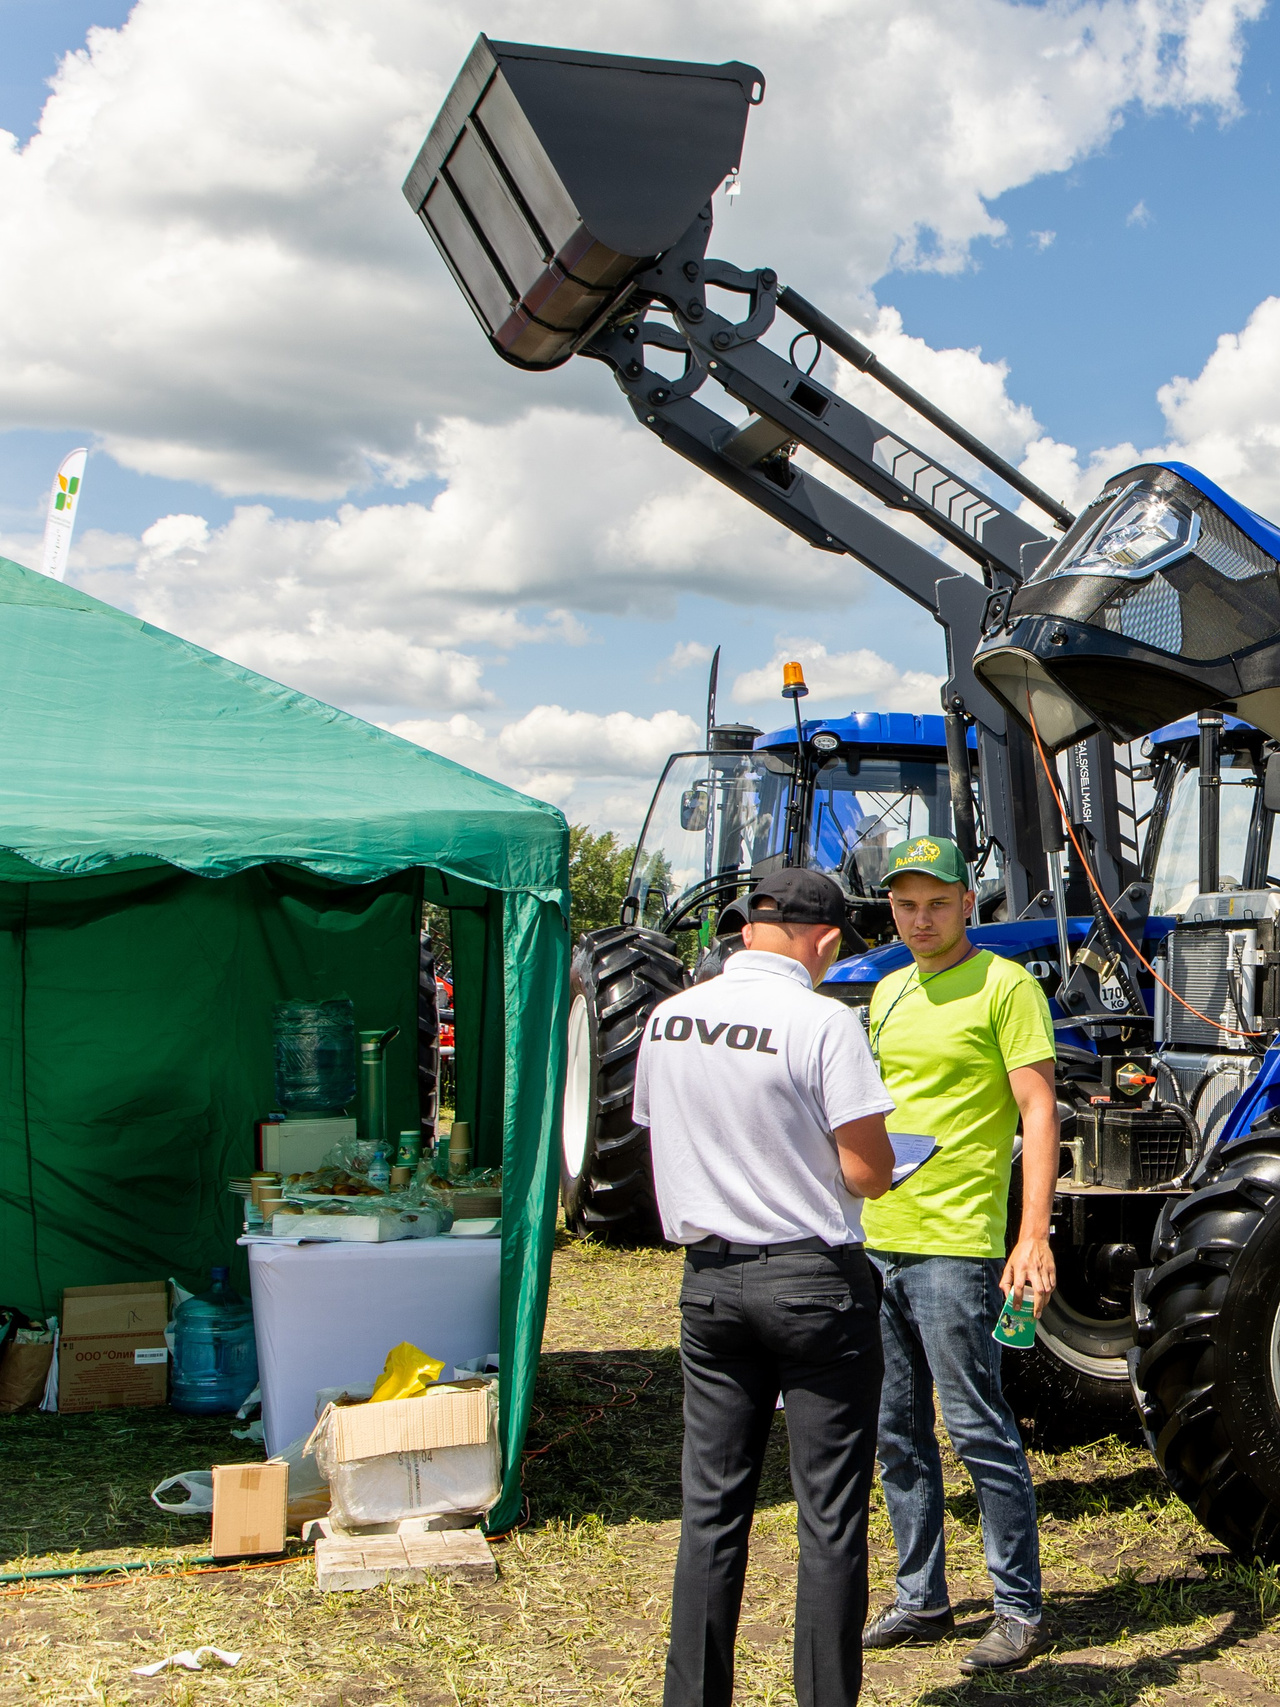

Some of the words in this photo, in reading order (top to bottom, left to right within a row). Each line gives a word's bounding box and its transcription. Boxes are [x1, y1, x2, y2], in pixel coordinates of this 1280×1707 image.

[1078, 739, 1092, 823] SALSKSELMASH
[1111, 1001, 1125, 1009] KG
[650, 1015, 778, 1055] LOVOL
[75, 1351, 101, 1362] ООО
